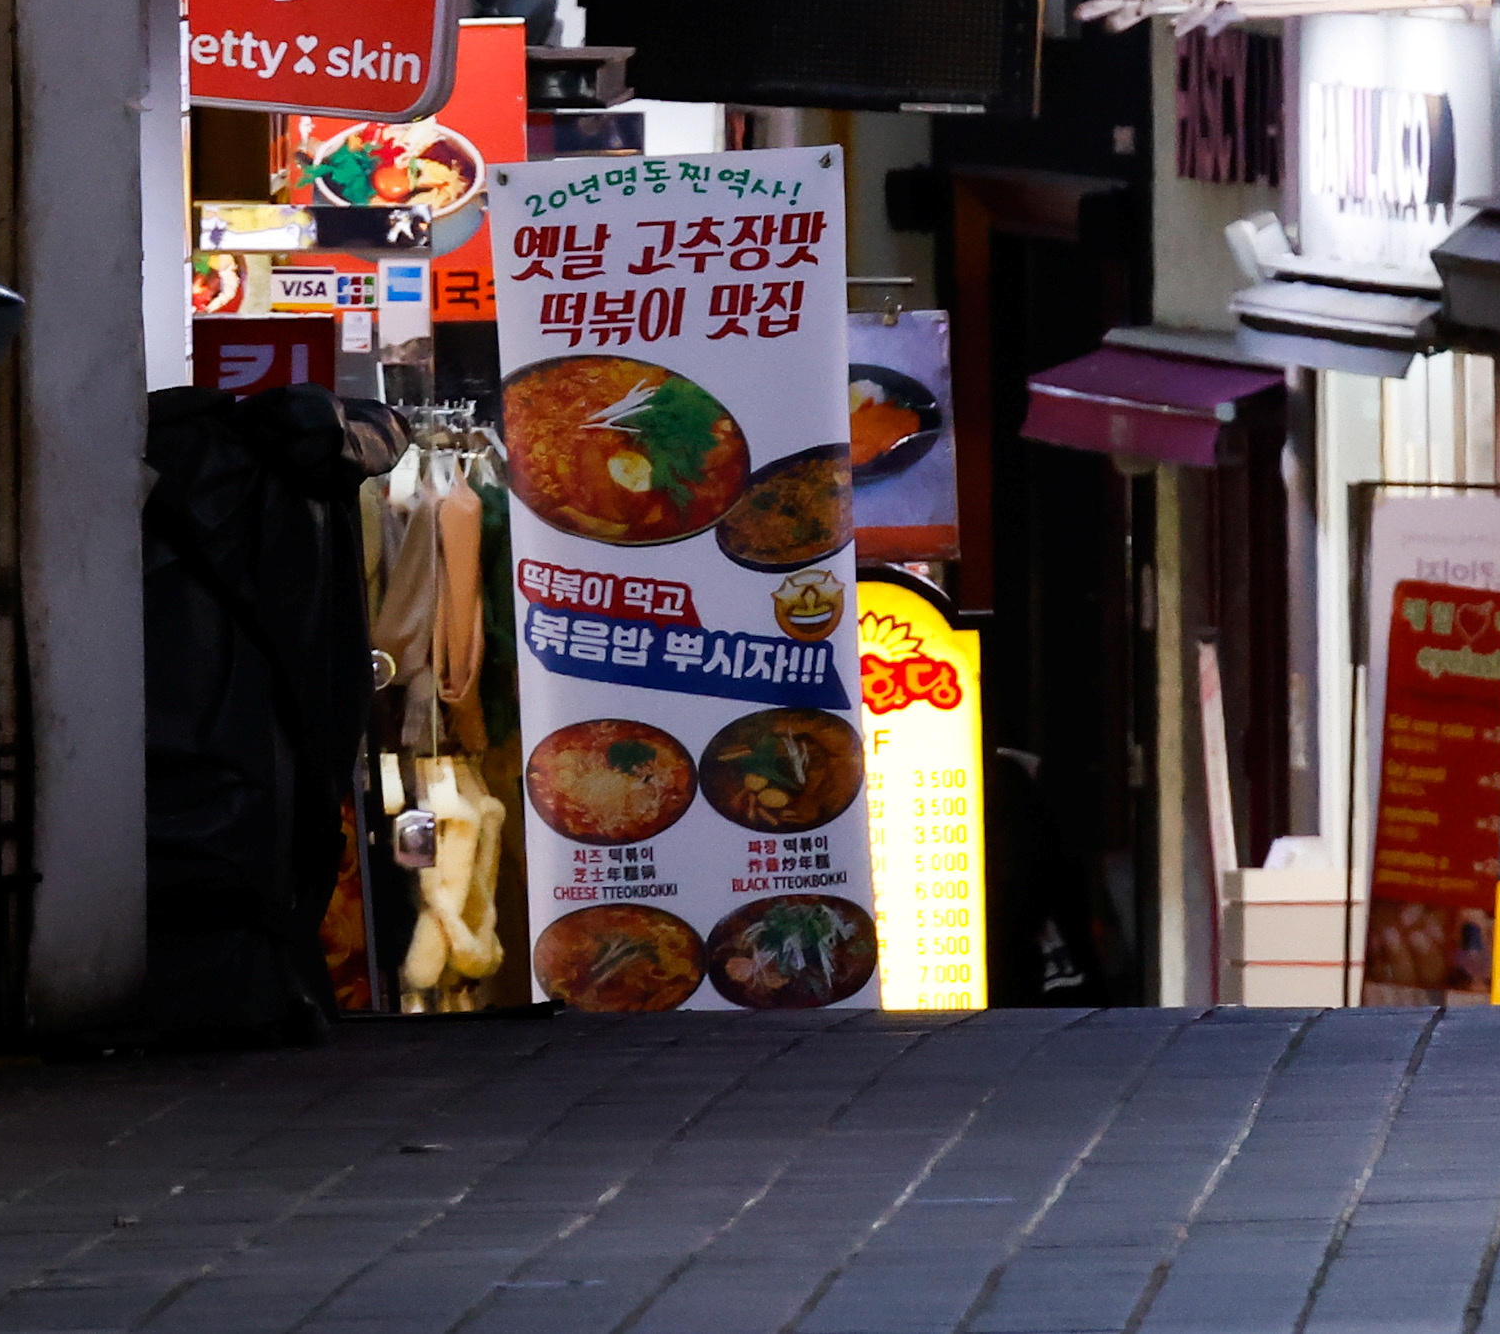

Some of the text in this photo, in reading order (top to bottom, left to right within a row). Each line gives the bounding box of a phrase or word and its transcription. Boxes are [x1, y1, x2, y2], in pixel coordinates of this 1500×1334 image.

[190, 28, 422, 86] etty skin
[510, 210, 828, 282] 옛날 고추장맛
[278, 279, 329, 299] VISA
[540, 280, 806, 348] 떡볶이 맛집
[522, 563, 687, 618] 떡볶이 먹고
[530, 609, 828, 686] 볶음밥 뿌시자!!!
[608, 846, 655, 864] 떡볶이
[783, 835, 830, 853] 떡볶이
[553, 882, 679, 901] CHEESE TTEOKBOKKI
[731, 870, 849, 893] BLACK TTEOKBOKKI
